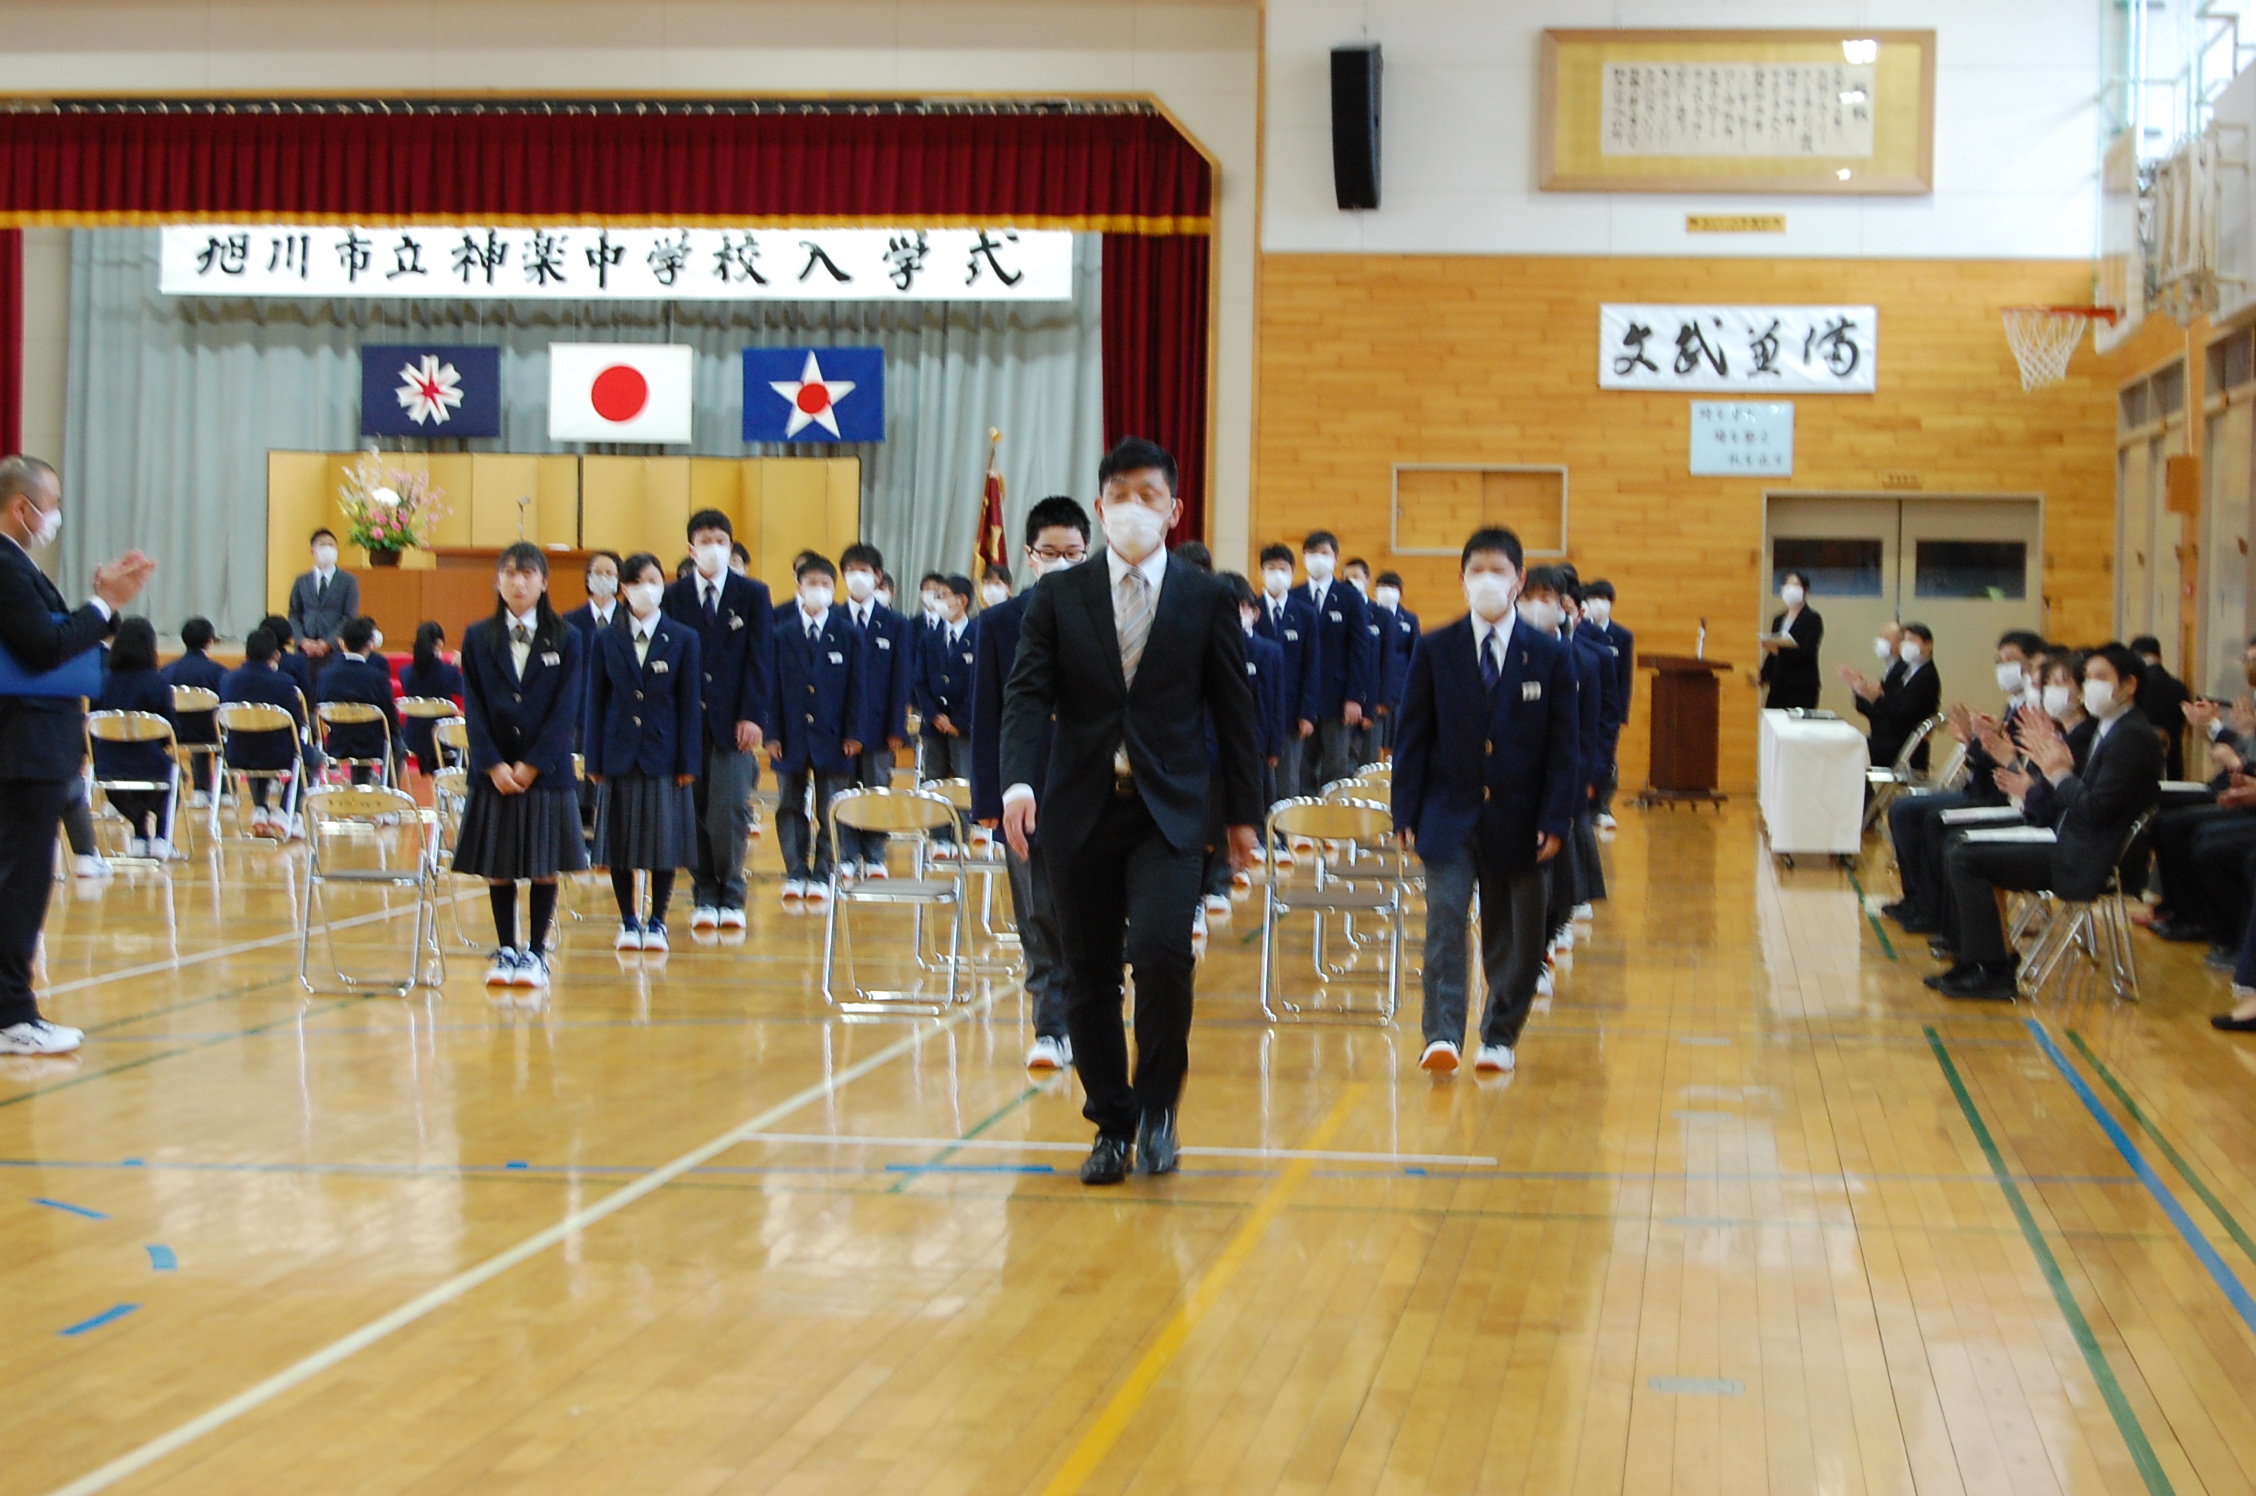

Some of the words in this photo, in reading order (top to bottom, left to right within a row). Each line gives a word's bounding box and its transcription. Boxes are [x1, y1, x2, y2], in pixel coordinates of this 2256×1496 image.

[196, 228, 1025, 290] 旭川市立神楽中学校入学式
